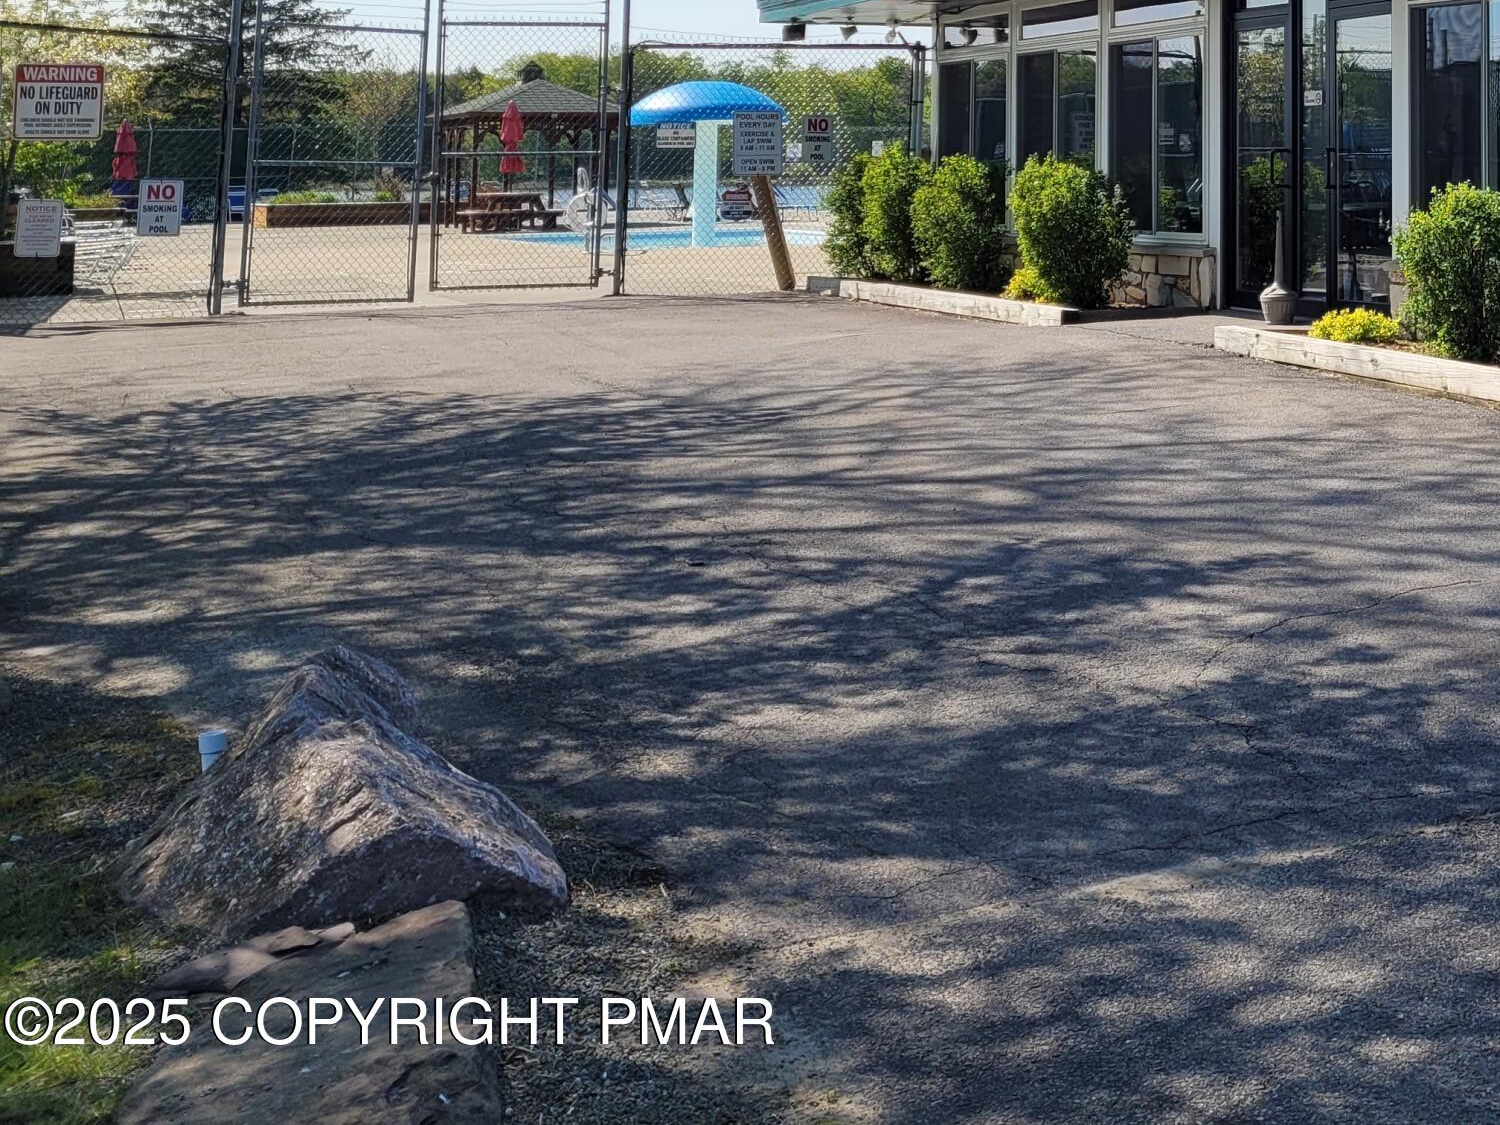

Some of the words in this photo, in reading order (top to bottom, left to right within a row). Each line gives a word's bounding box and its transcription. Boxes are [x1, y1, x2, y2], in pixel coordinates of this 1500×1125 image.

[23, 66, 98, 81] WARNING
[20, 86, 35, 100] NO
[39, 86, 98, 100] LIFEGUARD
[35, 101, 50, 115] ON
[54, 101, 82, 115] DUTY
[808, 119, 829, 132] NO
[147, 184, 175, 200] NO
[142, 205, 177, 213] SMOKING
